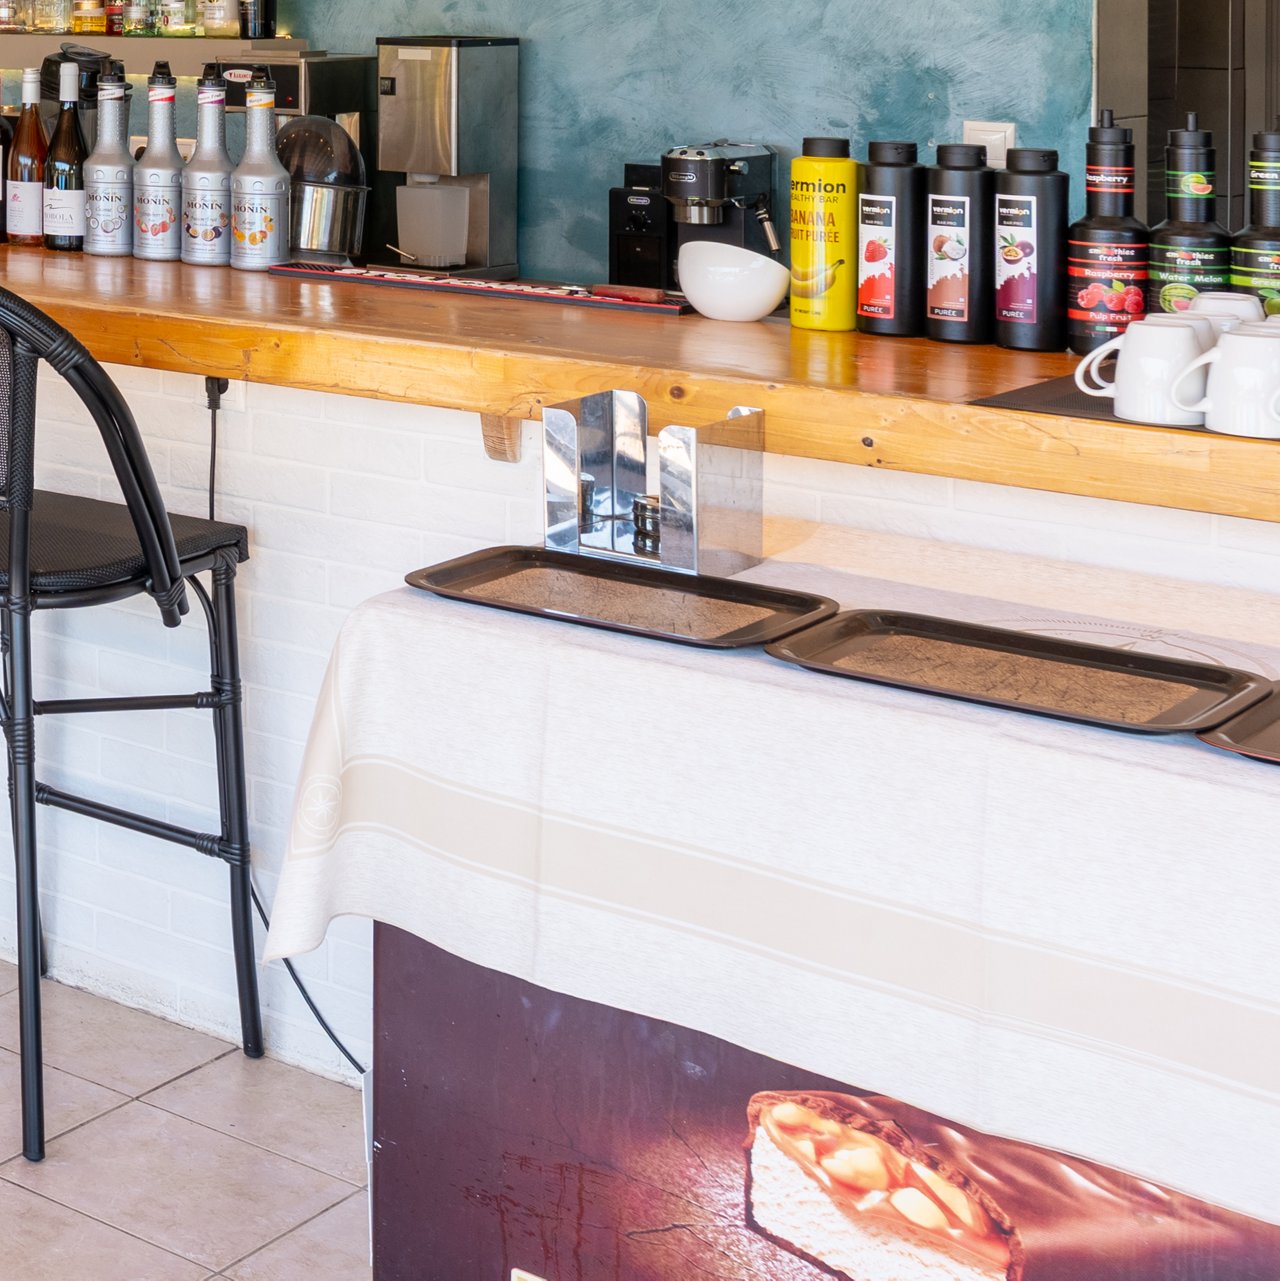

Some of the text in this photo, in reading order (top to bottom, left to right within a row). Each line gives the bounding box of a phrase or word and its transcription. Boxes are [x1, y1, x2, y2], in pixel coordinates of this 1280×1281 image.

[1250, 170, 1279, 180] Green
[88, 193, 122, 203] MONIN
[136, 196, 171, 206] MONIN
[819, 195, 839, 205] BAR
[186, 200, 224, 211] MONIN
[233, 204, 270, 214] MONIN
[862, 205, 891, 214] vermion
[933, 206, 964, 215] vermion
[999, 207, 1030, 216] vermion
[805, 228, 840, 244] PURÉE
[1099, 254, 1123, 263] fresh
[1176, 257, 1202, 267] fresh
[1085, 268, 1135, 280] Raspberry
[1159, 271, 1223, 284] Water Melon
[863, 304, 884, 314] PURÉE
[934, 307, 957, 317] PURÉE
[1002, 308, 1025, 319] PURÉE
[1090, 310, 1132, 321] Pulp Fruit
